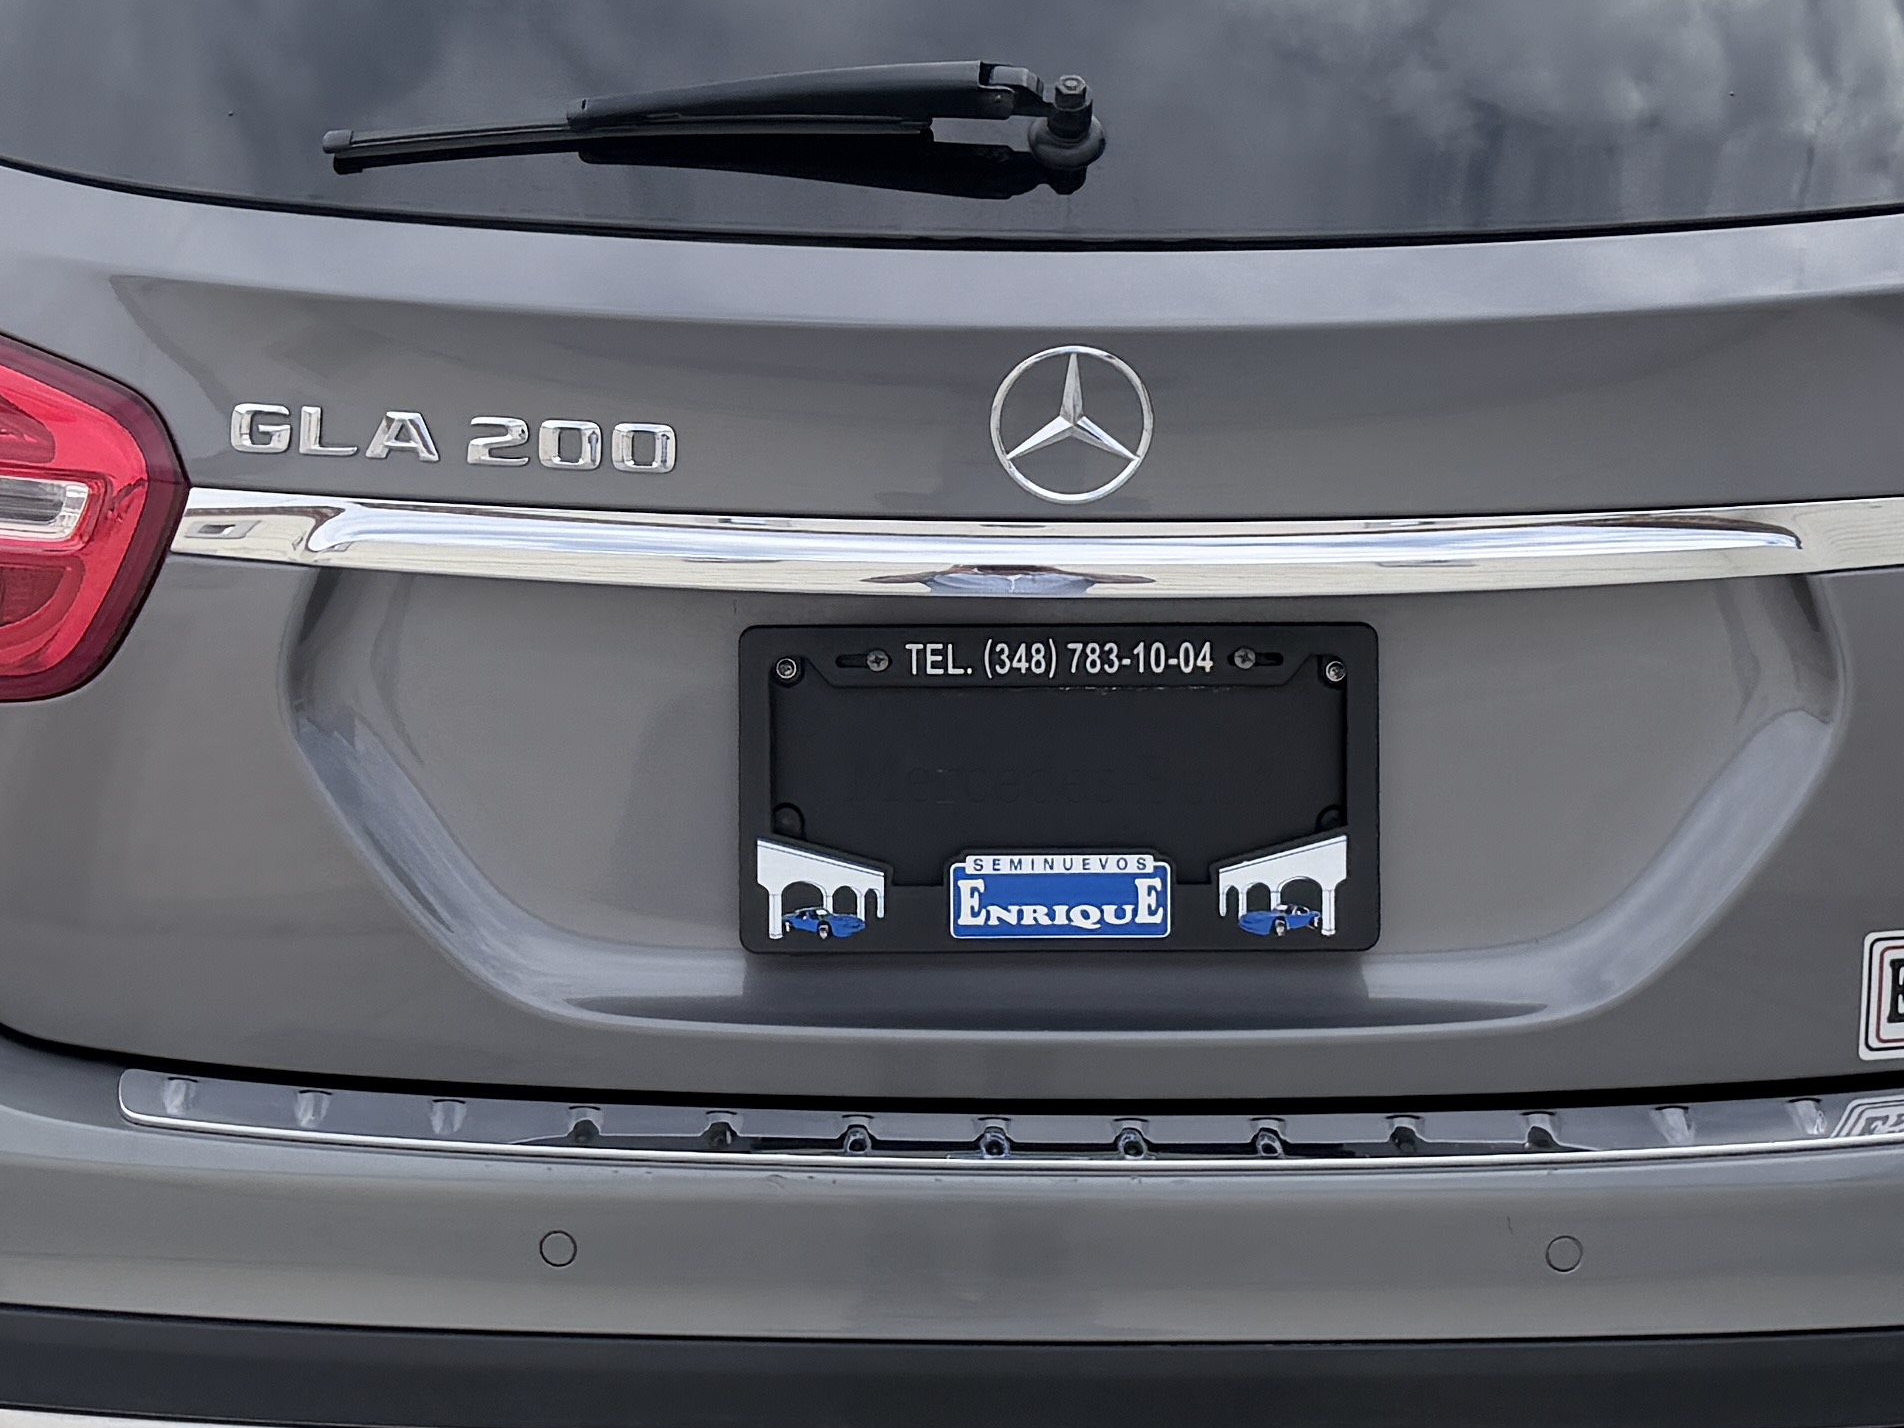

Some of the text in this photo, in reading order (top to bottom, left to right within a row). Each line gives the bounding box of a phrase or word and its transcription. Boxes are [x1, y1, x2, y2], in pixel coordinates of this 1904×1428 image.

[230, 402, 677, 473] GLA 200
[905, 638, 1214, 679] TEL. (348) 783-10-04
[973, 857, 1147, 872] SEMINUEVOS
[957, 877, 1164, 930] ENRIQUE
